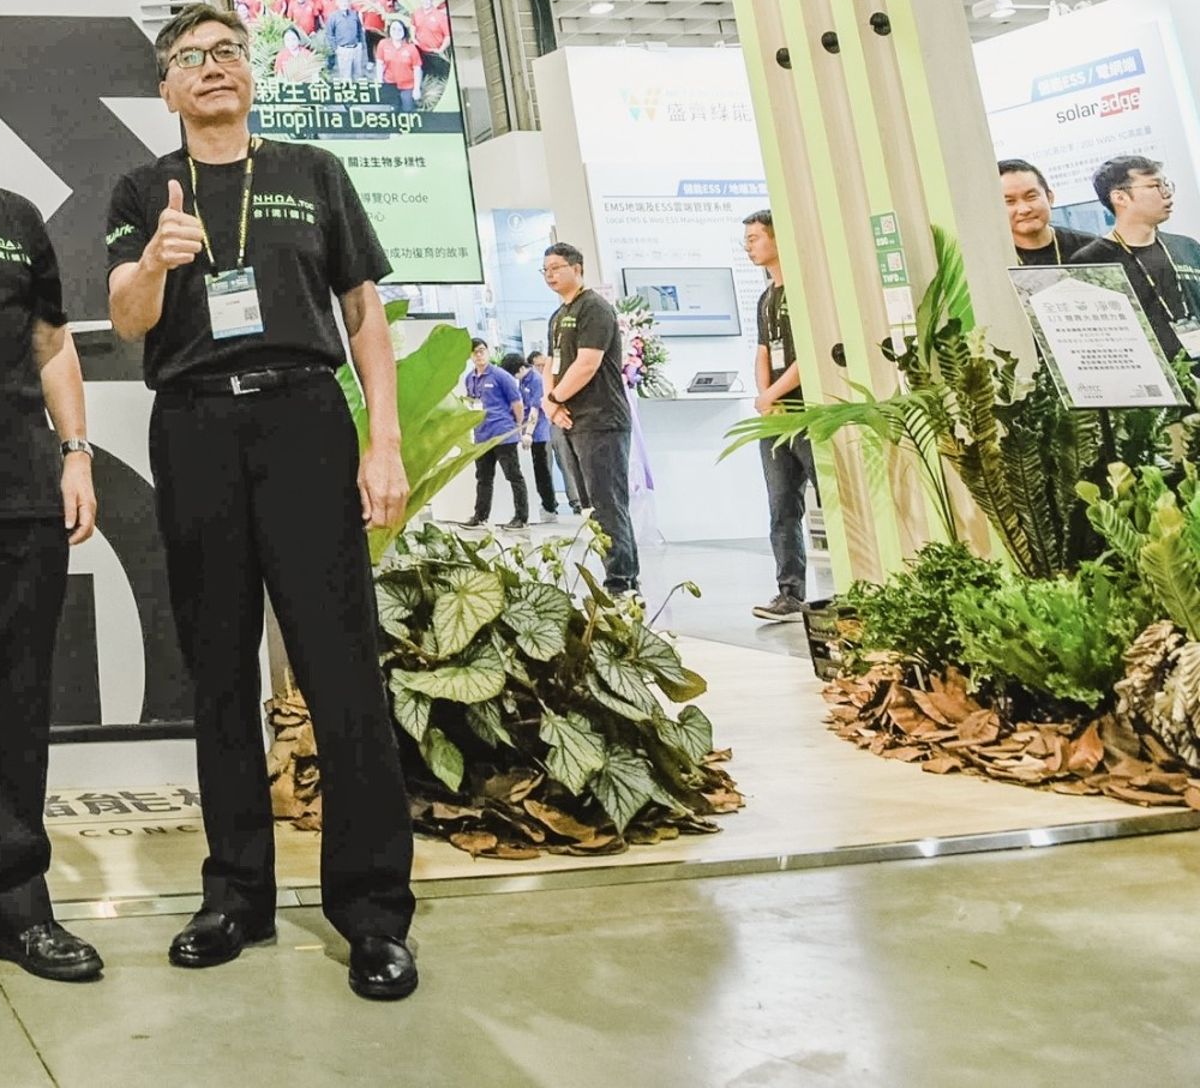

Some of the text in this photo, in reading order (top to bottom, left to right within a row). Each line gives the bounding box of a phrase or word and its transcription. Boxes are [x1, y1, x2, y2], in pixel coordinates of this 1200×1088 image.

[256, 78, 382, 103] 親生命設計
[350, 108, 423, 134] Design
